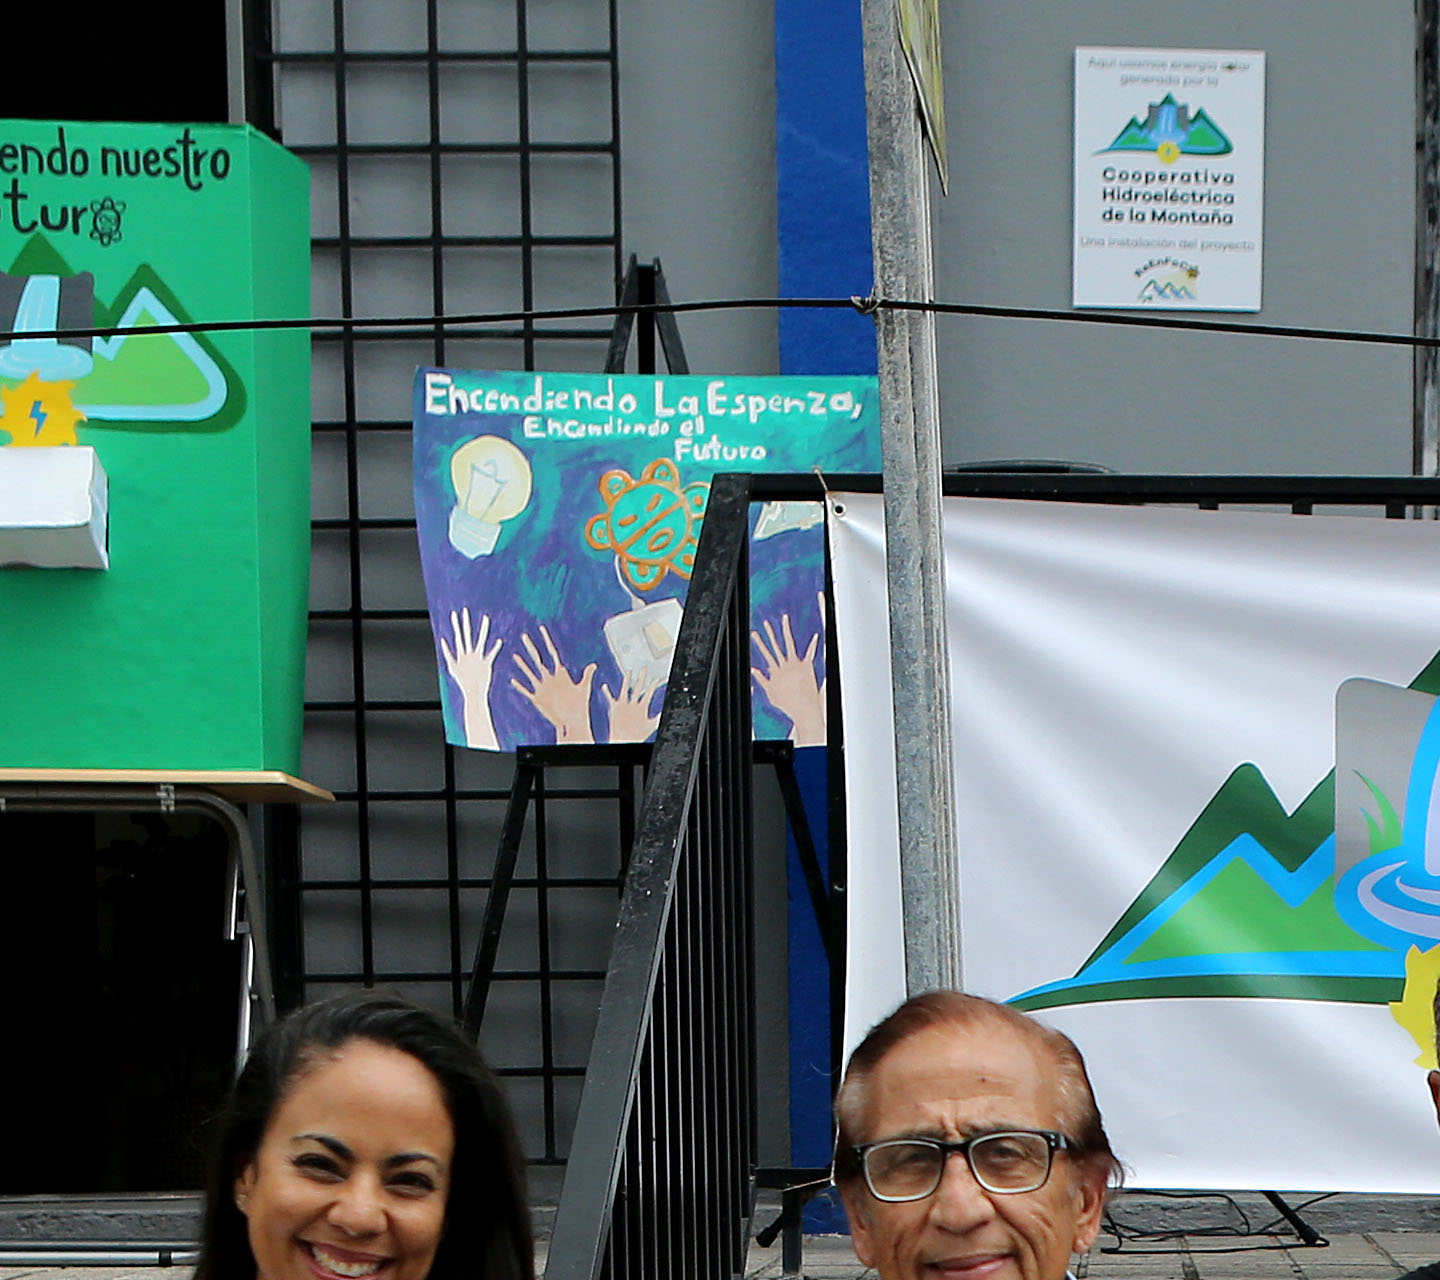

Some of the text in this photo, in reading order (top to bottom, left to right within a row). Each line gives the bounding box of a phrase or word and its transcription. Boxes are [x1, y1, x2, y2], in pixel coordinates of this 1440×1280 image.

[101, 127, 231, 192] nuestro
[1102, 166, 1235, 185] Cooperativa
[1102, 185, 1235, 205] Hidroeléctrica
[1101, 206, 1234, 225] de la Montaña
[424, 372, 862, 424] Encendiendo La Espenza,
[523, 415, 705, 439] Encendiendo el
[673, 436, 767, 462] Futuro
